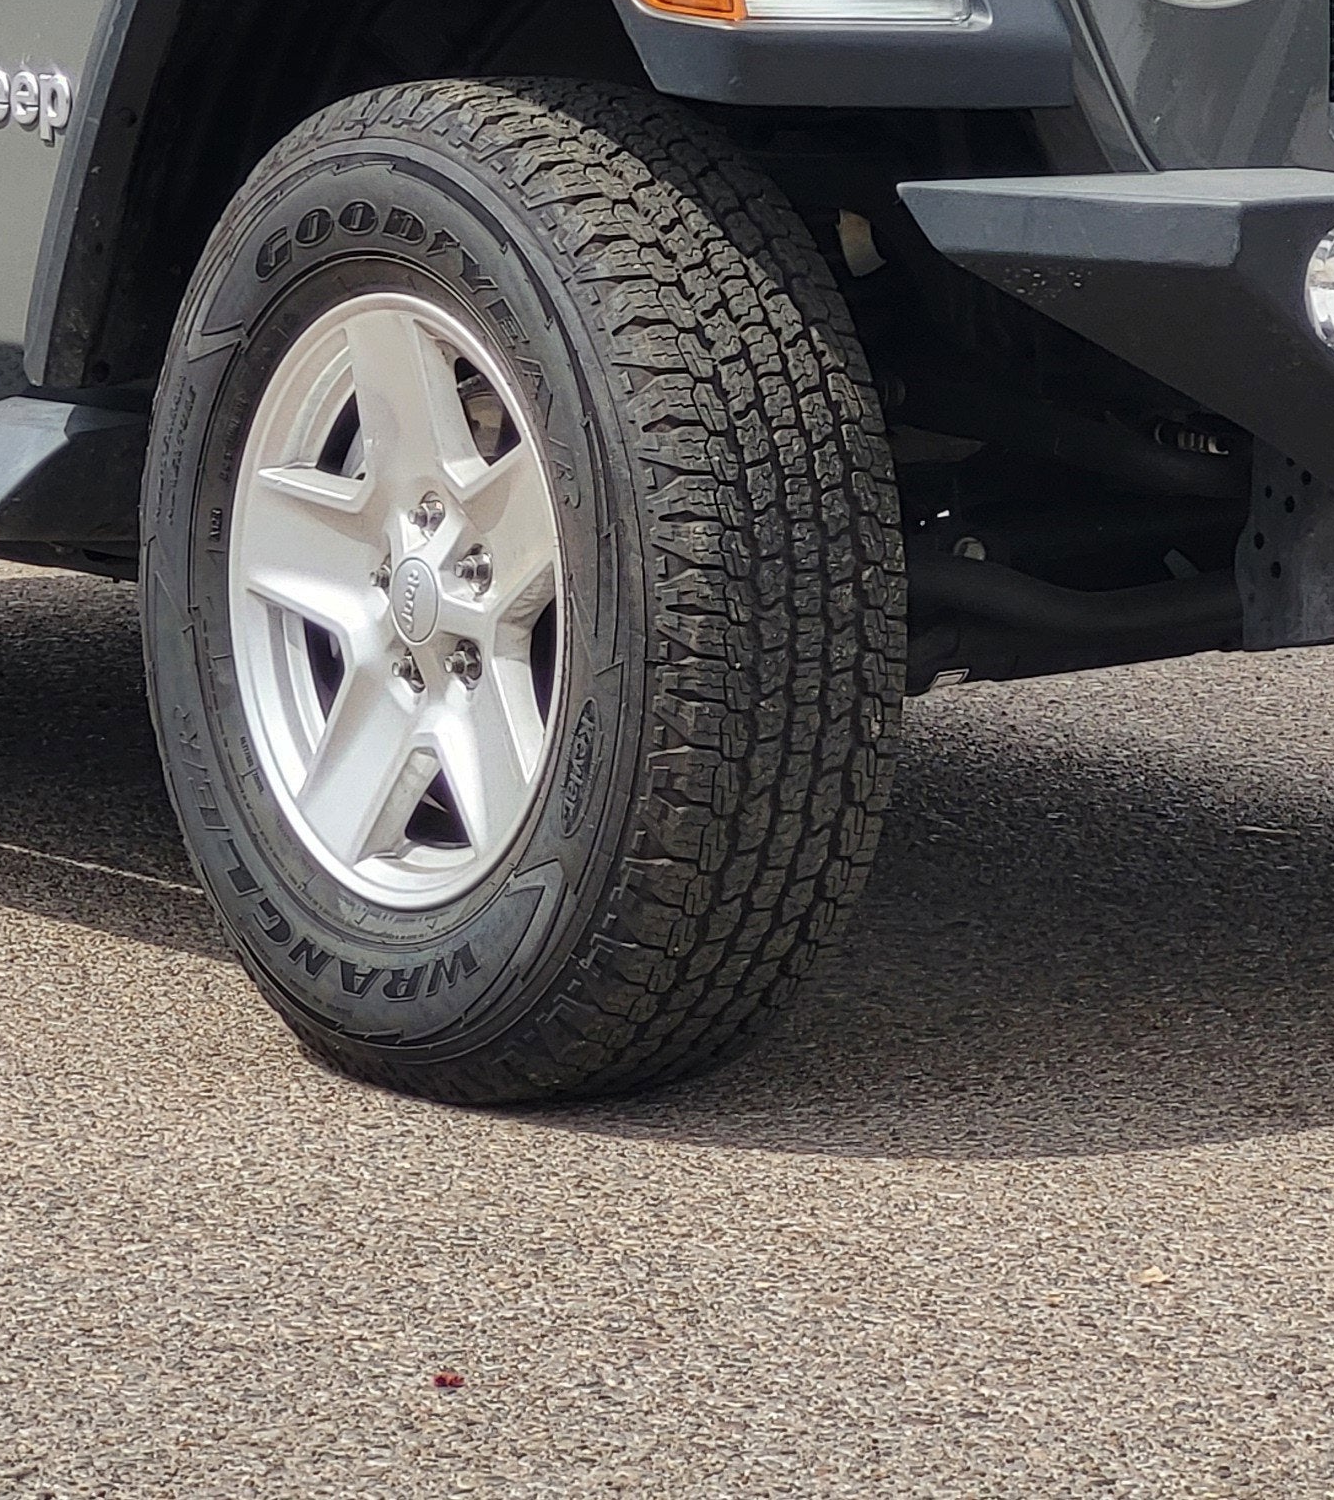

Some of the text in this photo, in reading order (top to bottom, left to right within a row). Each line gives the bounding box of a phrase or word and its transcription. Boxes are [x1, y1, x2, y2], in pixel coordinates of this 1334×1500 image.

[255, 199, 582, 510] GOODYEAR
[171, 703, 483, 1006] WRANGLER
[563, 715, 597, 818] Kevlar
